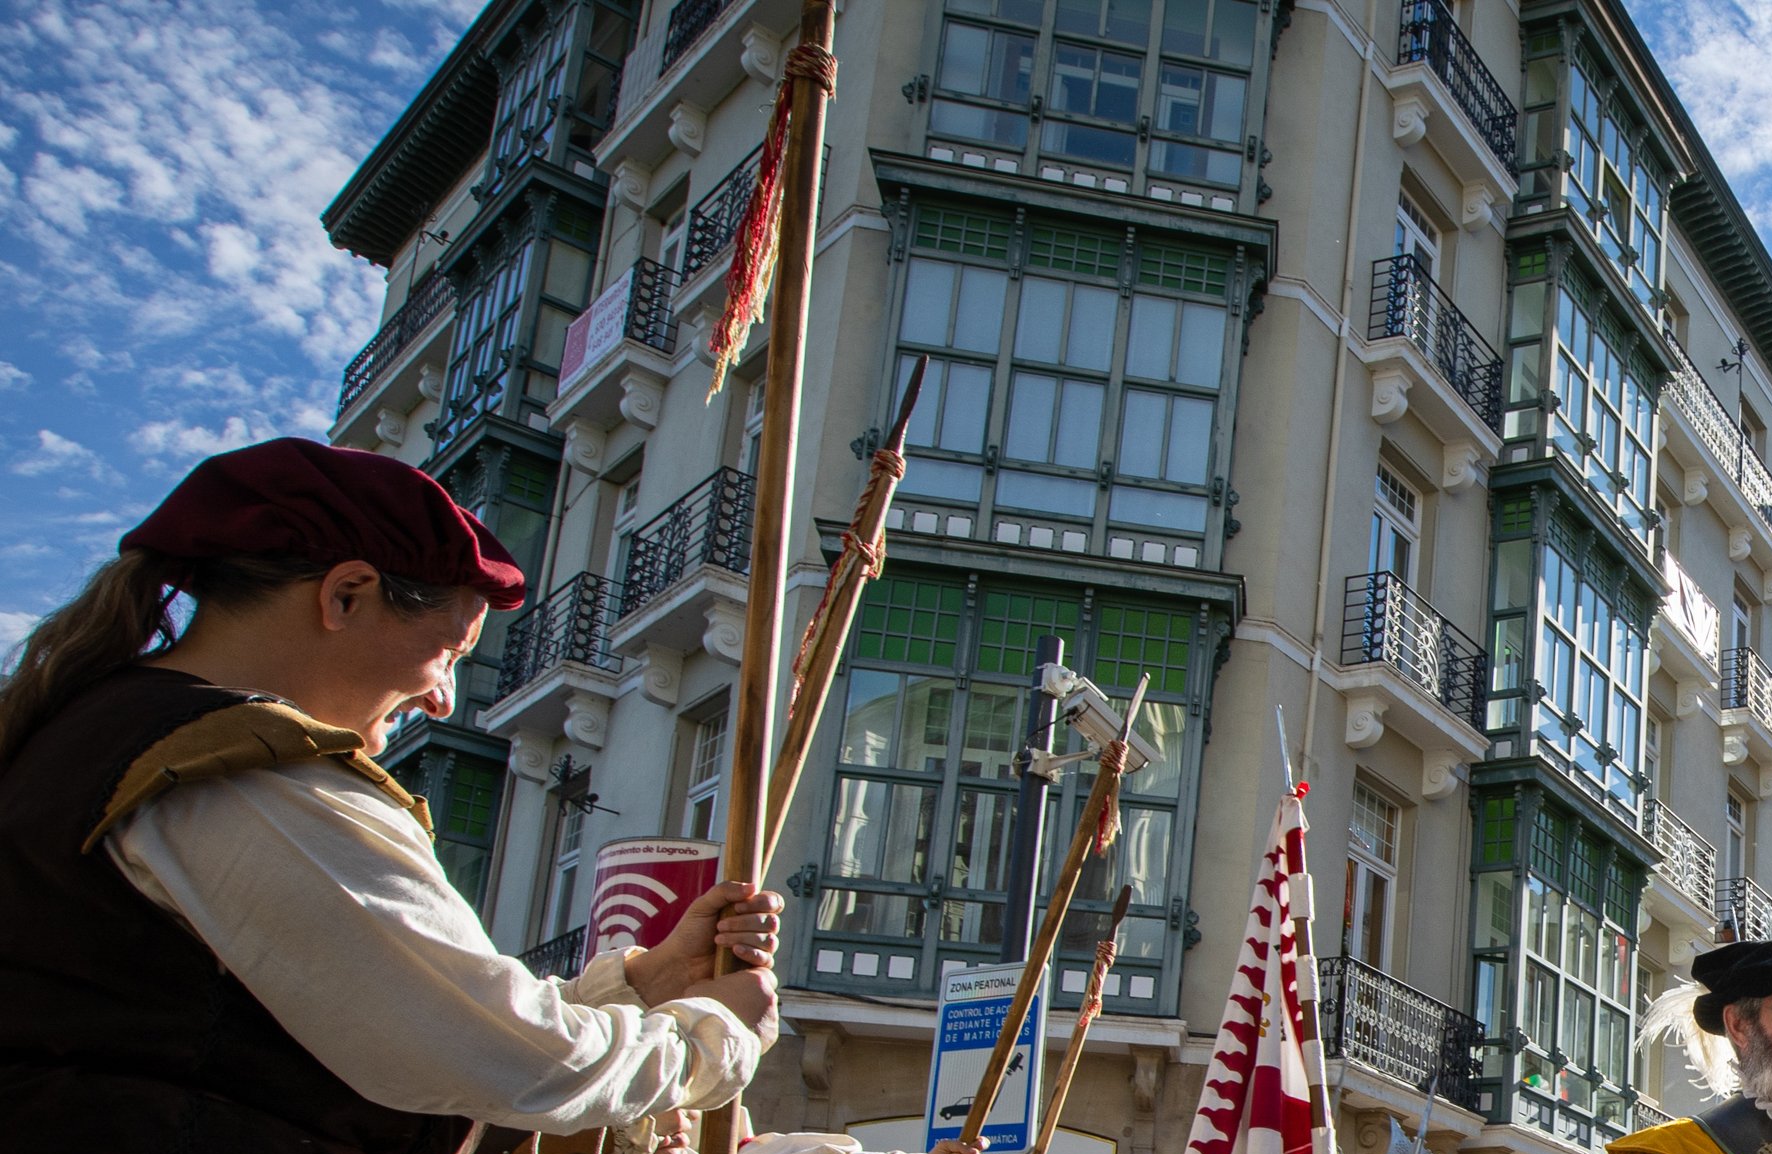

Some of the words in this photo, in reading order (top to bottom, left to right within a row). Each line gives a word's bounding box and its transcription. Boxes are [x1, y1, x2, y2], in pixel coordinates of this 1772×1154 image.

[642, 845, 654, 854] de
[656, 845, 699, 856] Logroño
[949, 981, 973, 993] ZONA
[974, 976, 1016, 990] PEATONAL
[947, 1007, 983, 1020] CONTROL
[984, 1006, 995, 1016] DE
[946, 1018, 990, 1031] MEDIANTE
[944, 1033, 957, 1043] DE
